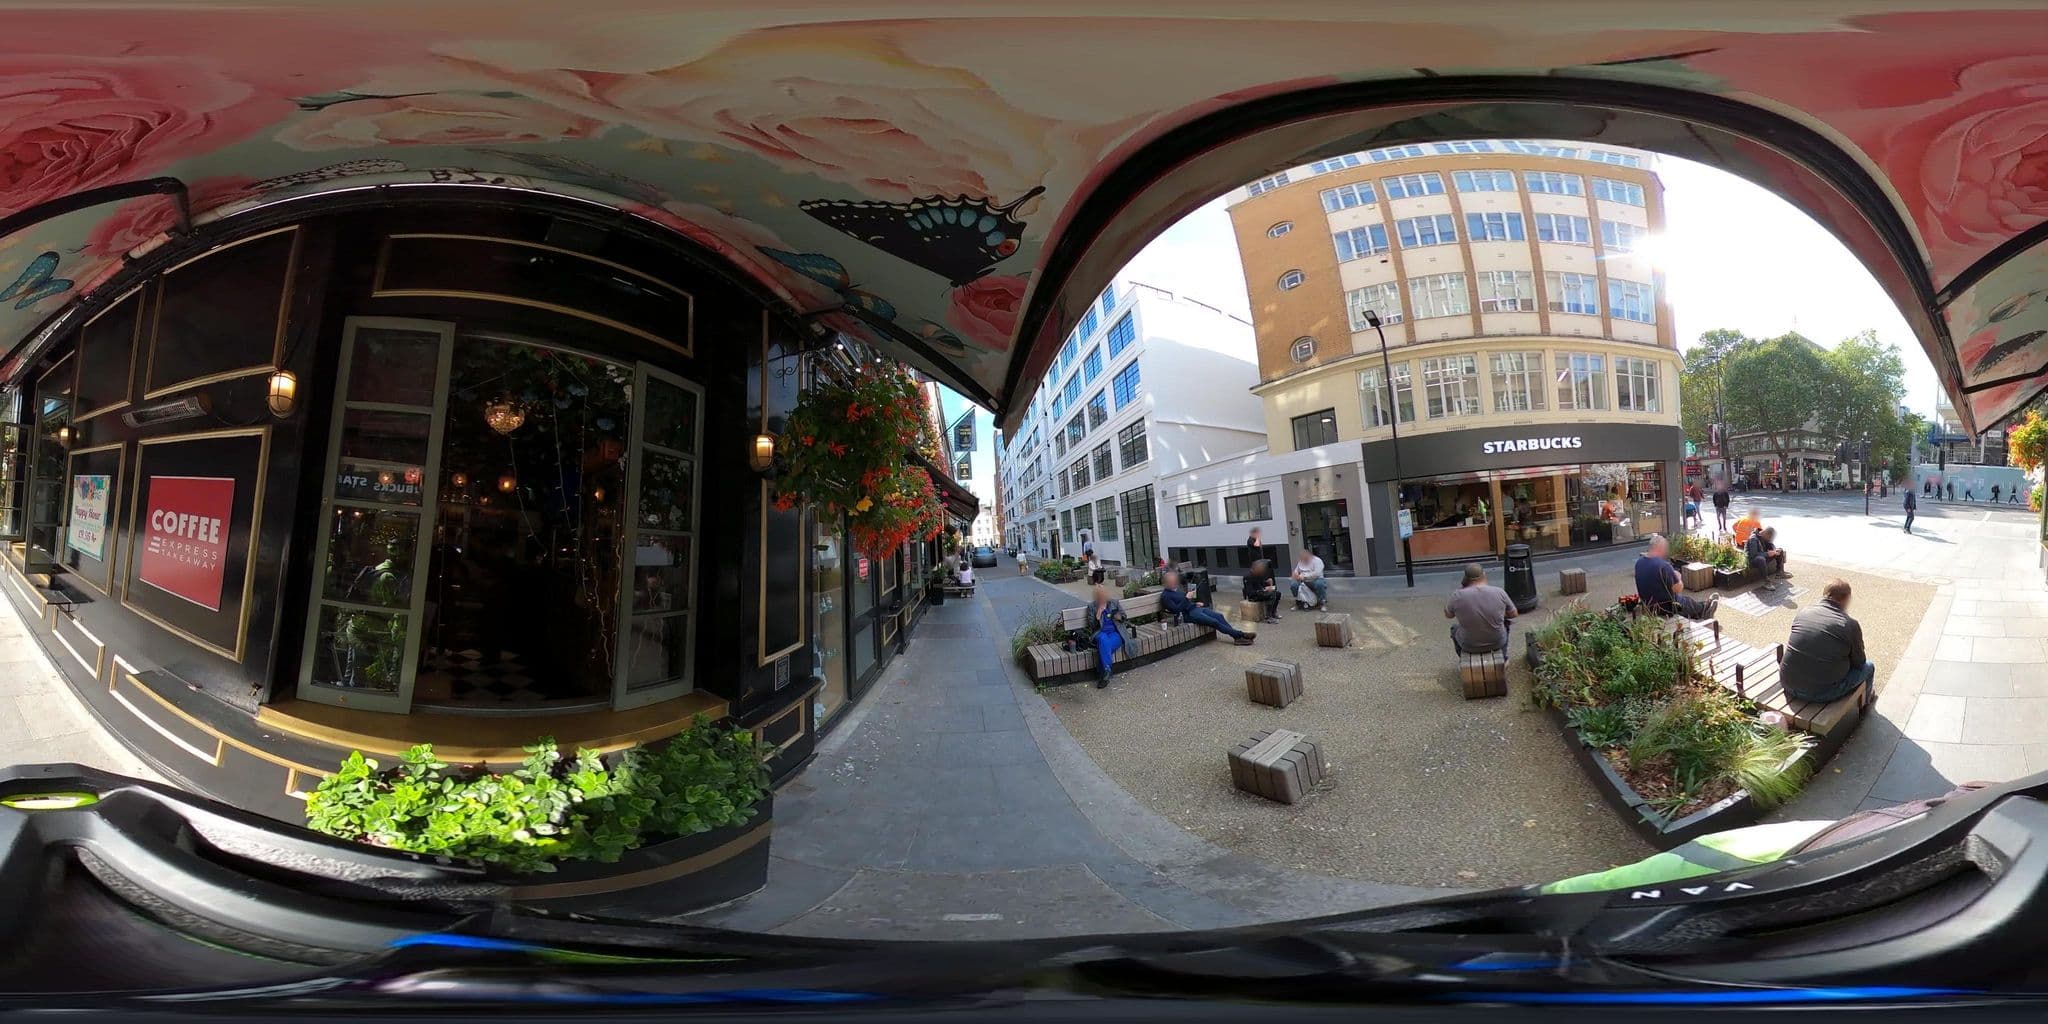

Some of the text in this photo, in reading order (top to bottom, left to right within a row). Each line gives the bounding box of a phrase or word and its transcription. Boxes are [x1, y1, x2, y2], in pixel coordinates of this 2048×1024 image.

[1483, 436, 1582, 454] STARBUCKS
[151, 509, 221, 545] COFFEE
[161, 538, 218, 561] EXPRESS
[161, 549, 216, 572] TAKEAWAY
